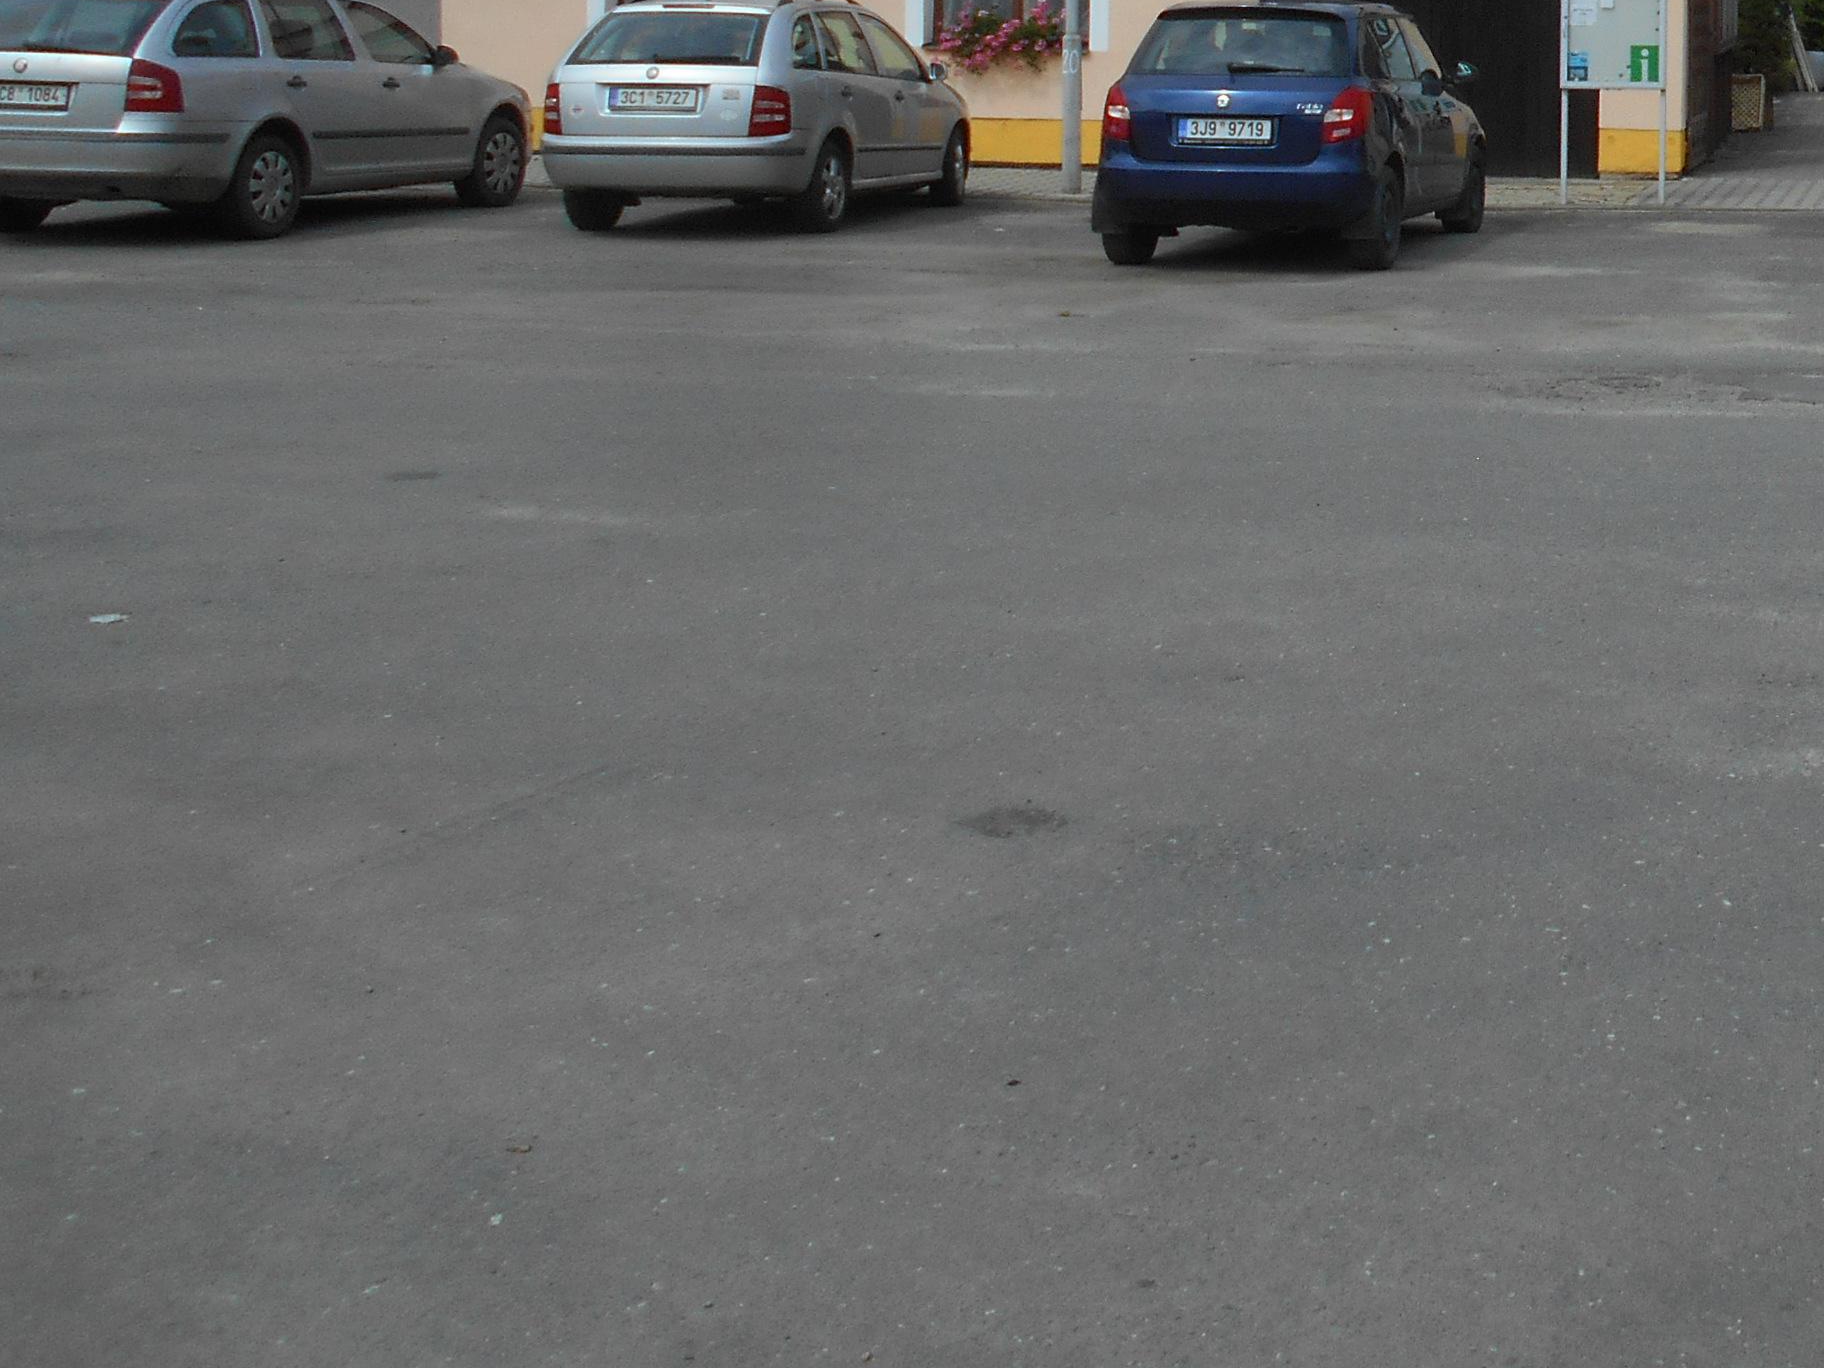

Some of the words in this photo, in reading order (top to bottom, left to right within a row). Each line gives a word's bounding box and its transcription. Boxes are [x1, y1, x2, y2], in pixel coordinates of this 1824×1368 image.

[28, 87, 60, 102] 1084
[621, 91, 646, 104] 3C1
[656, 91, 690, 105] 5727
[1191, 121, 1217, 136] 3J9
[1228, 121, 1264, 137] 9719
